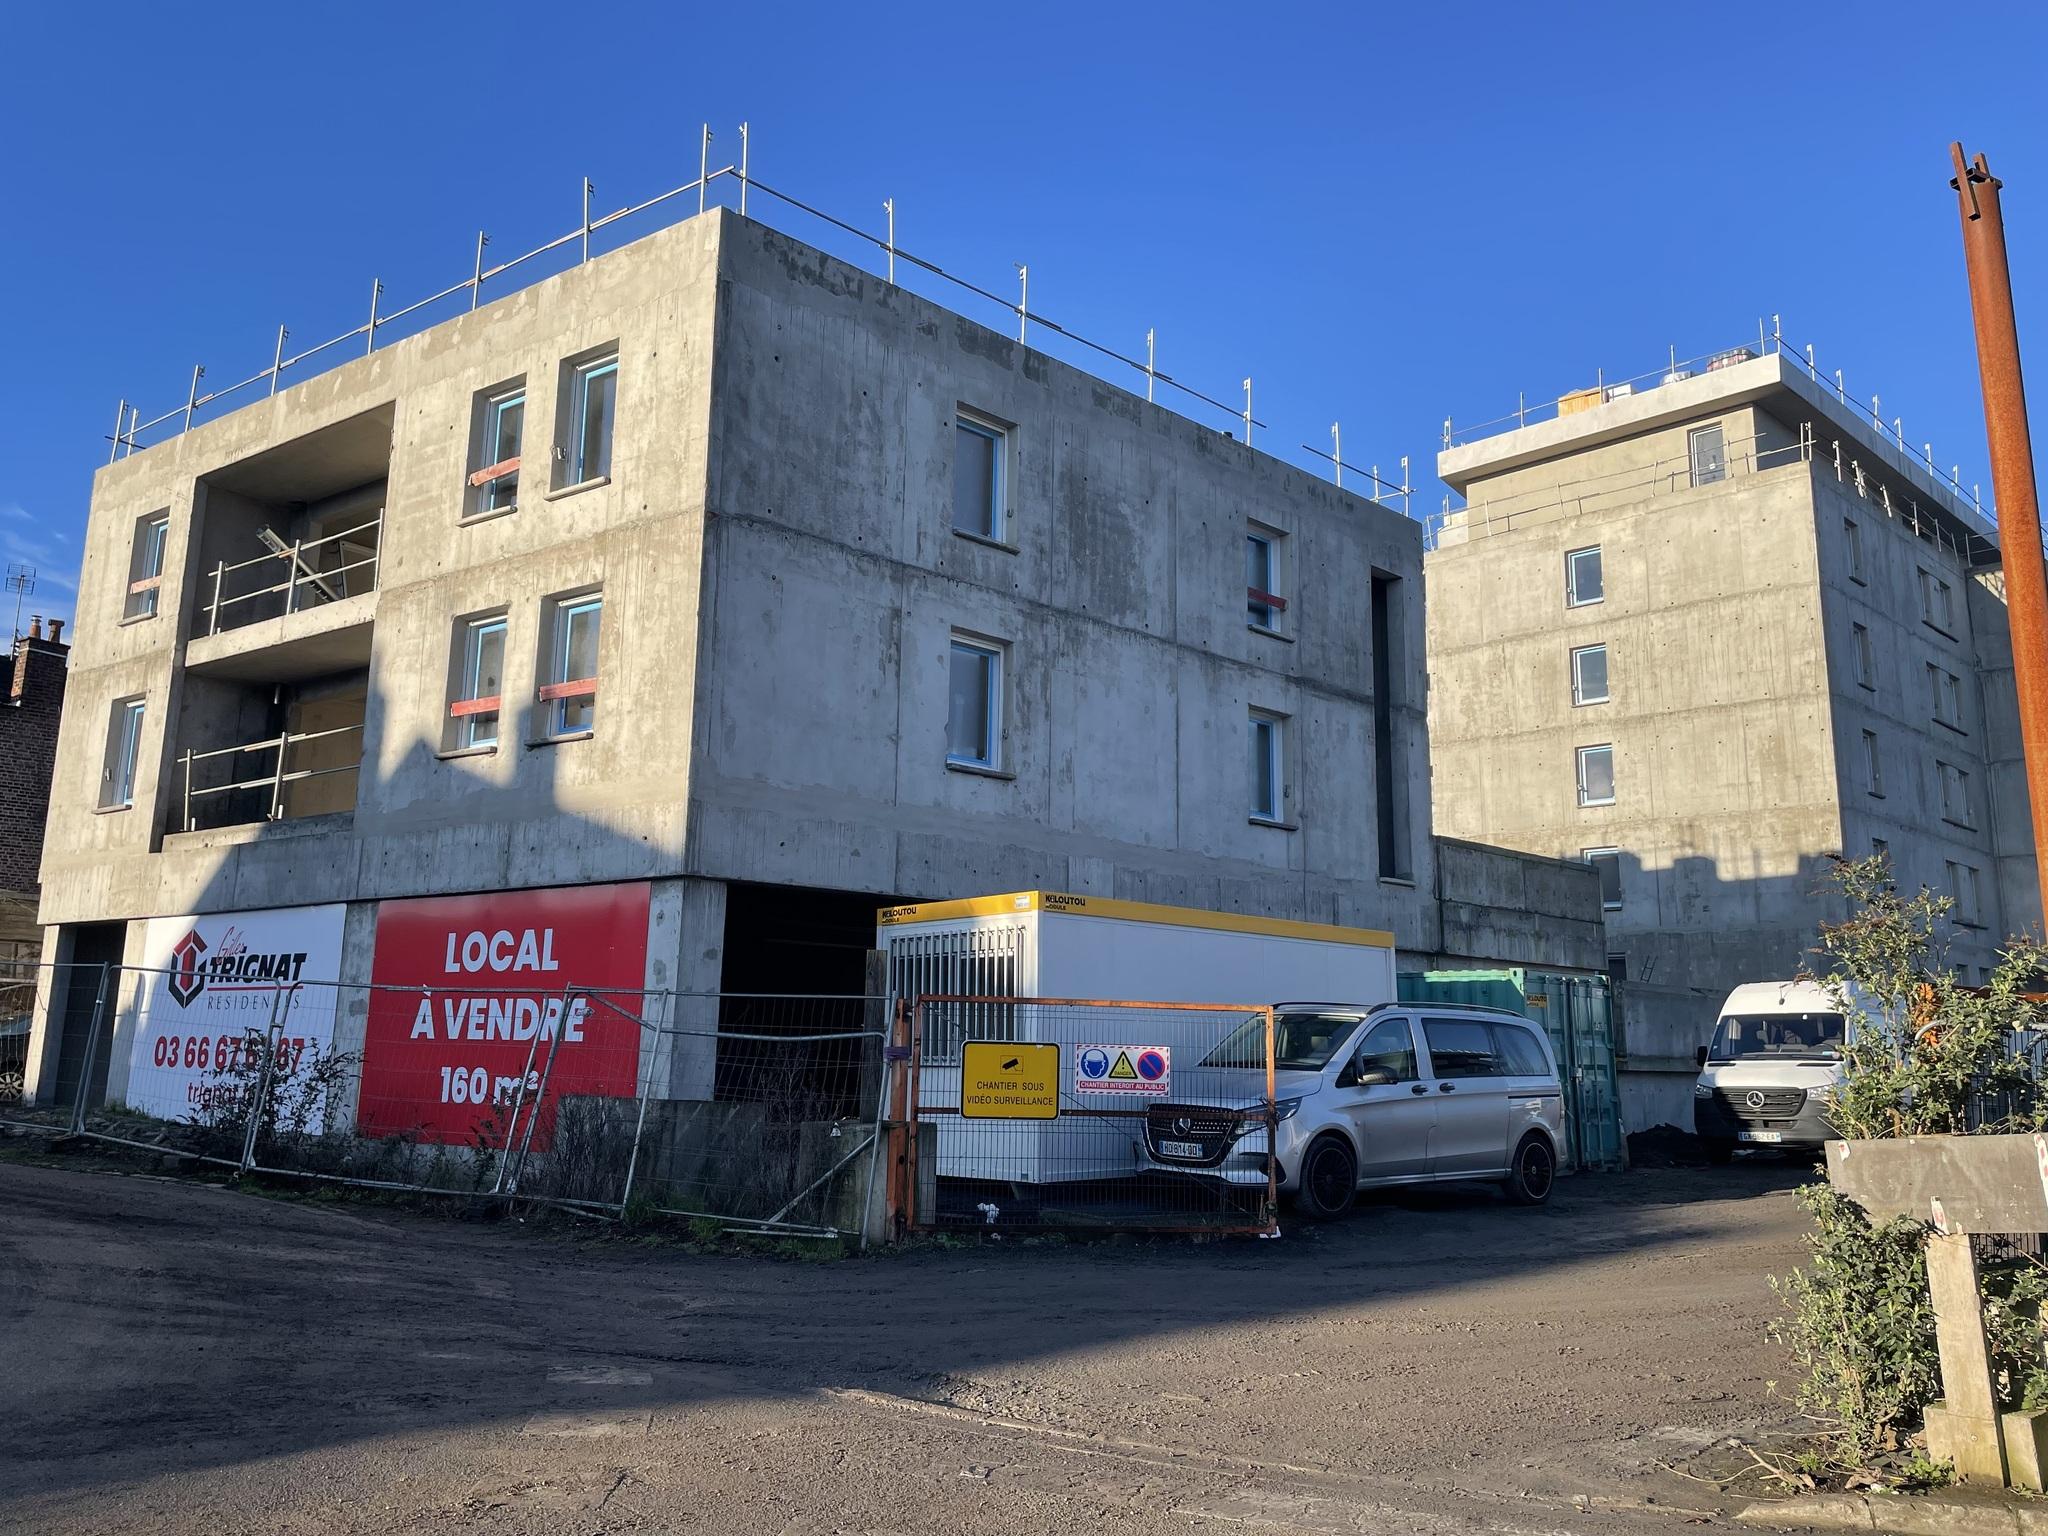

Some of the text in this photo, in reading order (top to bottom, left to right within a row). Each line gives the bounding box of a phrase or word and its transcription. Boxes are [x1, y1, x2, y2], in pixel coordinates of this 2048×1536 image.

[444, 928, 559, 973] LOCAL
[209, 953, 307, 983] TRIGNAT
[207, 994, 300, 1010] RESIDENS
[444, 998, 586, 1042] VENDRE
[154, 1036, 180, 1068] 03
[184, 1036, 210, 1069] 66
[440, 1066, 488, 1104] 160
[966, 1093, 1053, 1106] VIDÉO SURVEILLANCE
[976, 1081, 1044, 1091] CHANTIER SOUS
[1080, 1081, 1109, 1089] CHANTIER
